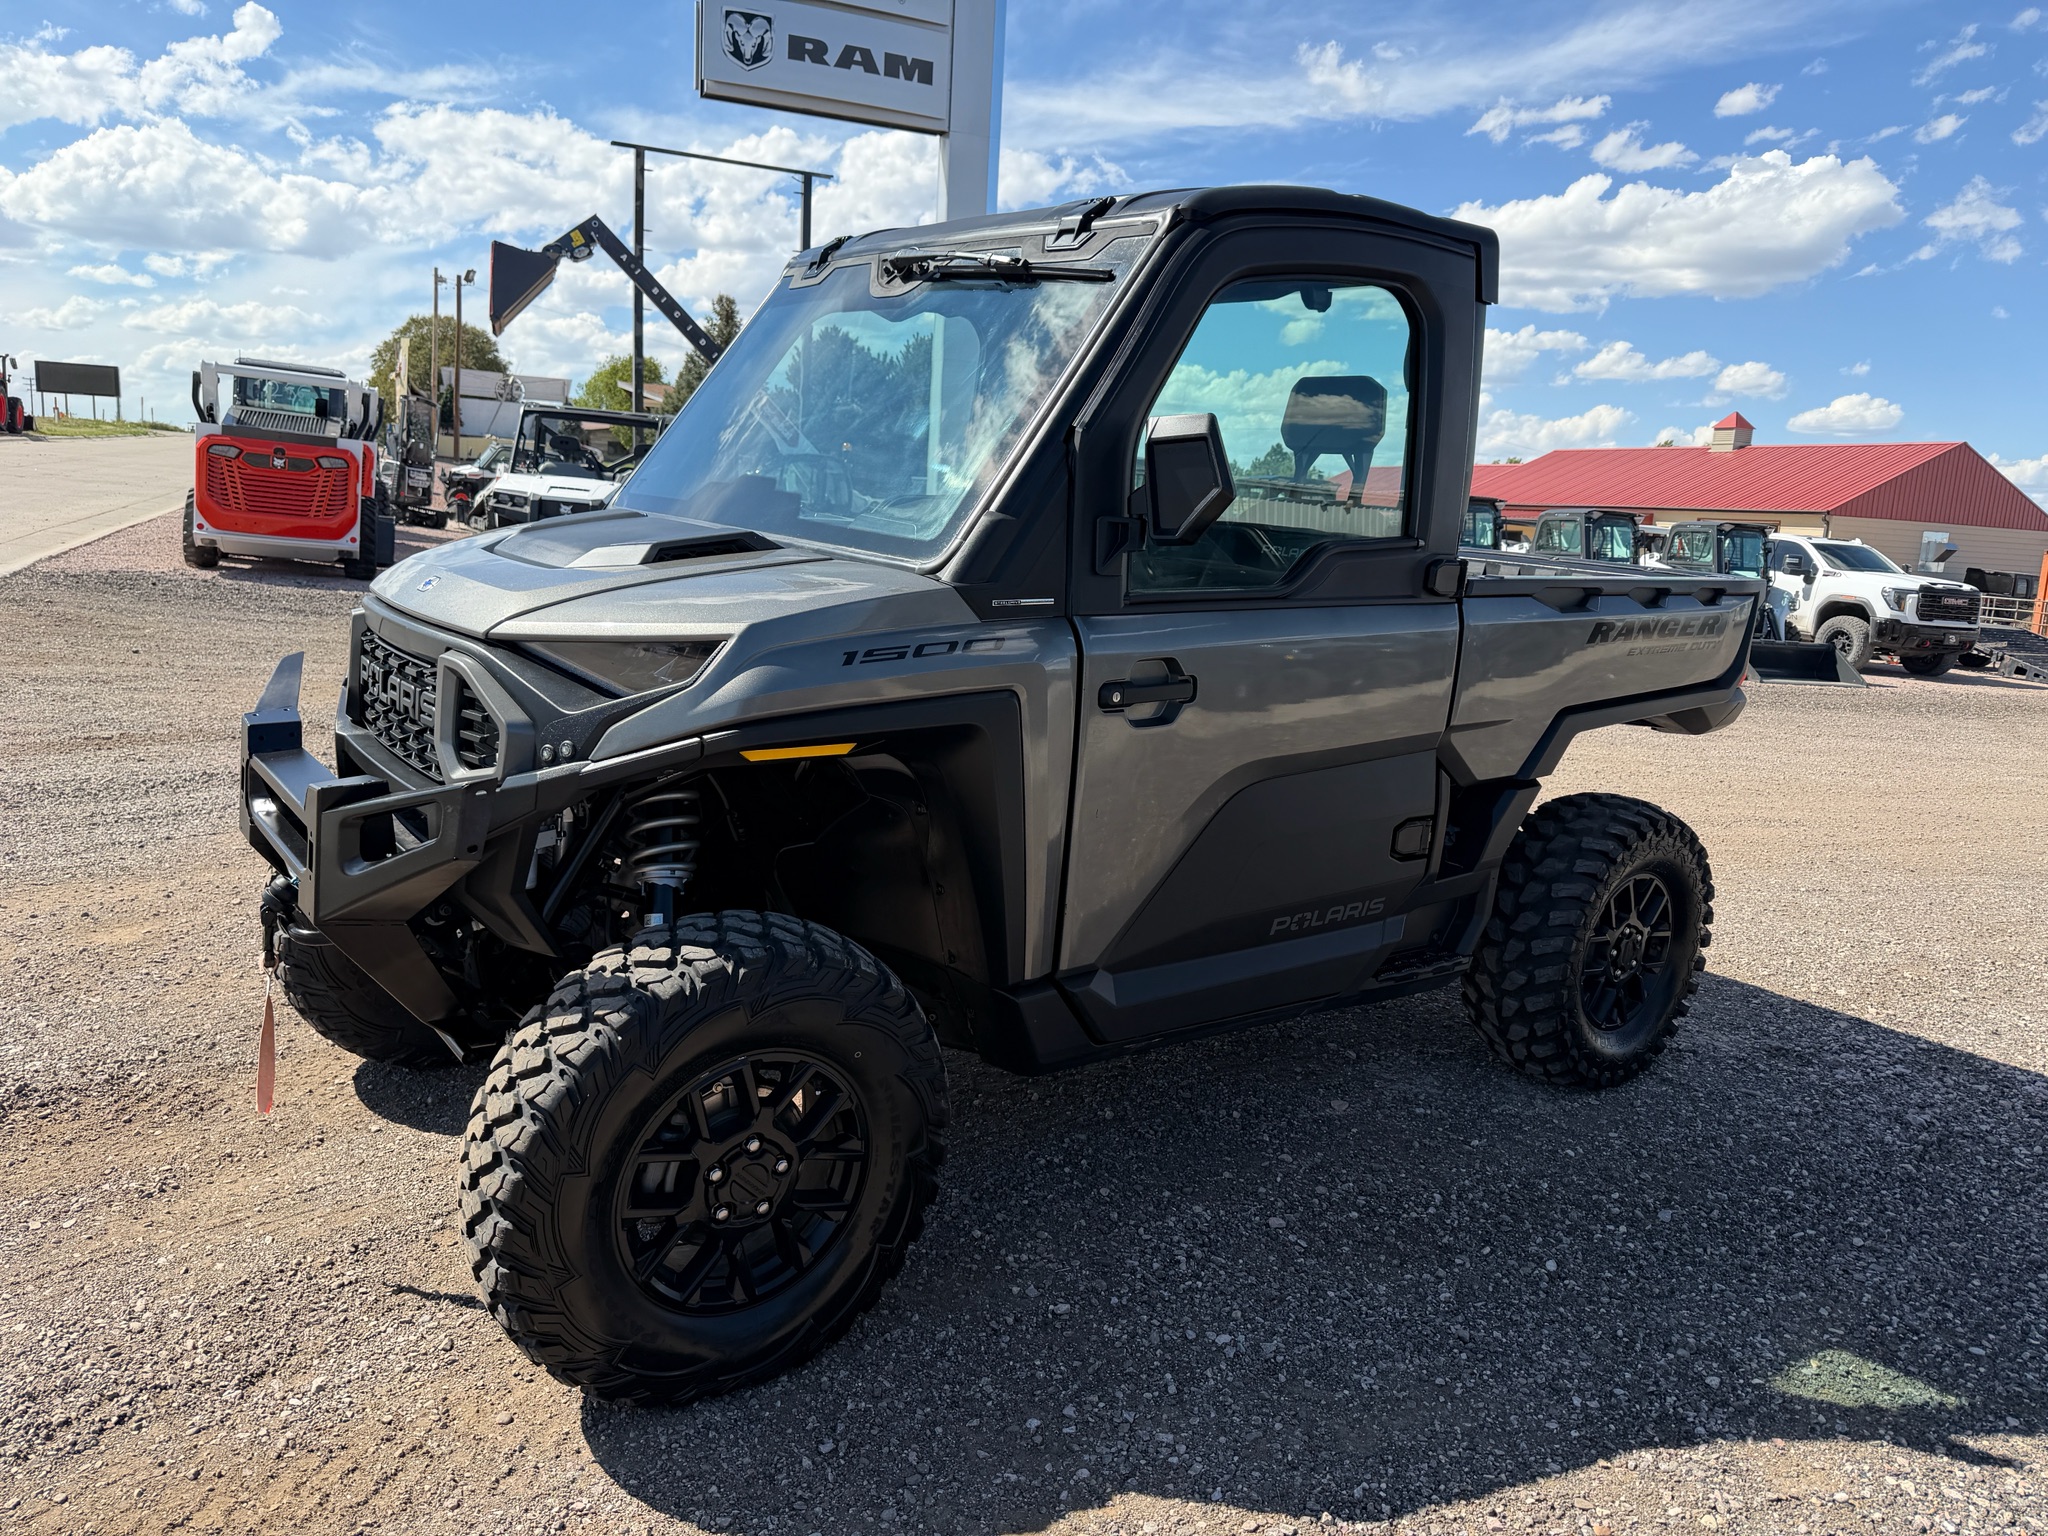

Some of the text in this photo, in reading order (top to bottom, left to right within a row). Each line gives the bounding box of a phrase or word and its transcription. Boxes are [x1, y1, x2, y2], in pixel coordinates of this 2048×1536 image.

[788, 34, 933, 86] RAM
[1586, 614, 1723, 645] RANGER
[841, 637, 1006, 667] 1500
[1627, 640, 1721, 657] EXTREME DUTY
[360, 654, 437, 728] POLARIS
[1269, 897, 1386, 936] POLARIS
